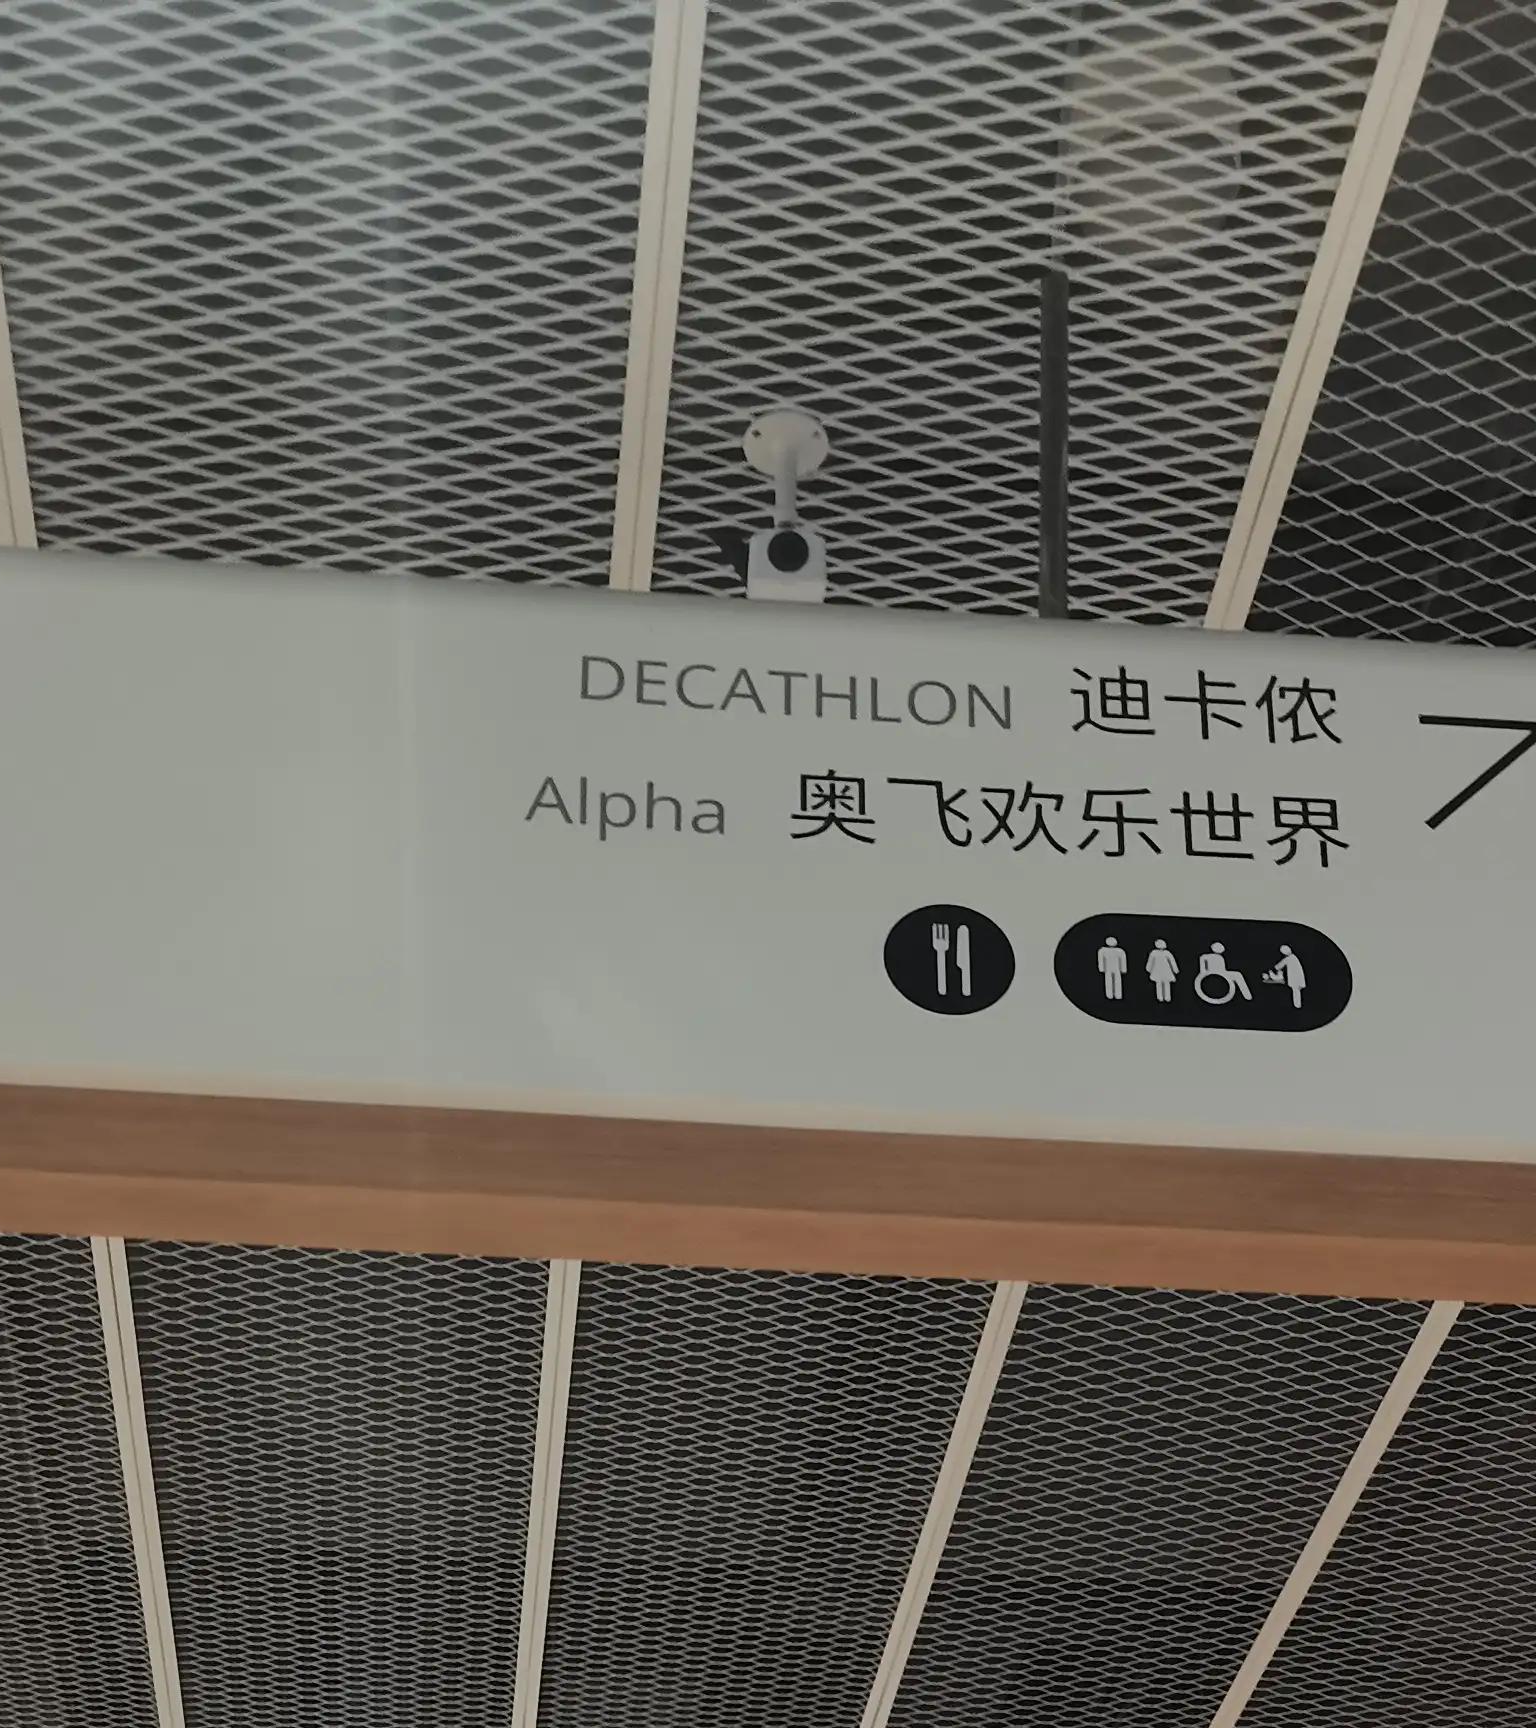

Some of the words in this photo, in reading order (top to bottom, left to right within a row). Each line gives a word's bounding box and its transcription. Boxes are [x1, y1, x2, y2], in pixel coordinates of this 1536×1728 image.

[579, 655, 1011, 729] DECATHLON
[1070, 665, 1343, 744] 迪卡侬
[525, 776, 725, 841] Alpha
[790, 769, 1350, 868] 奥飞欢乐世界
